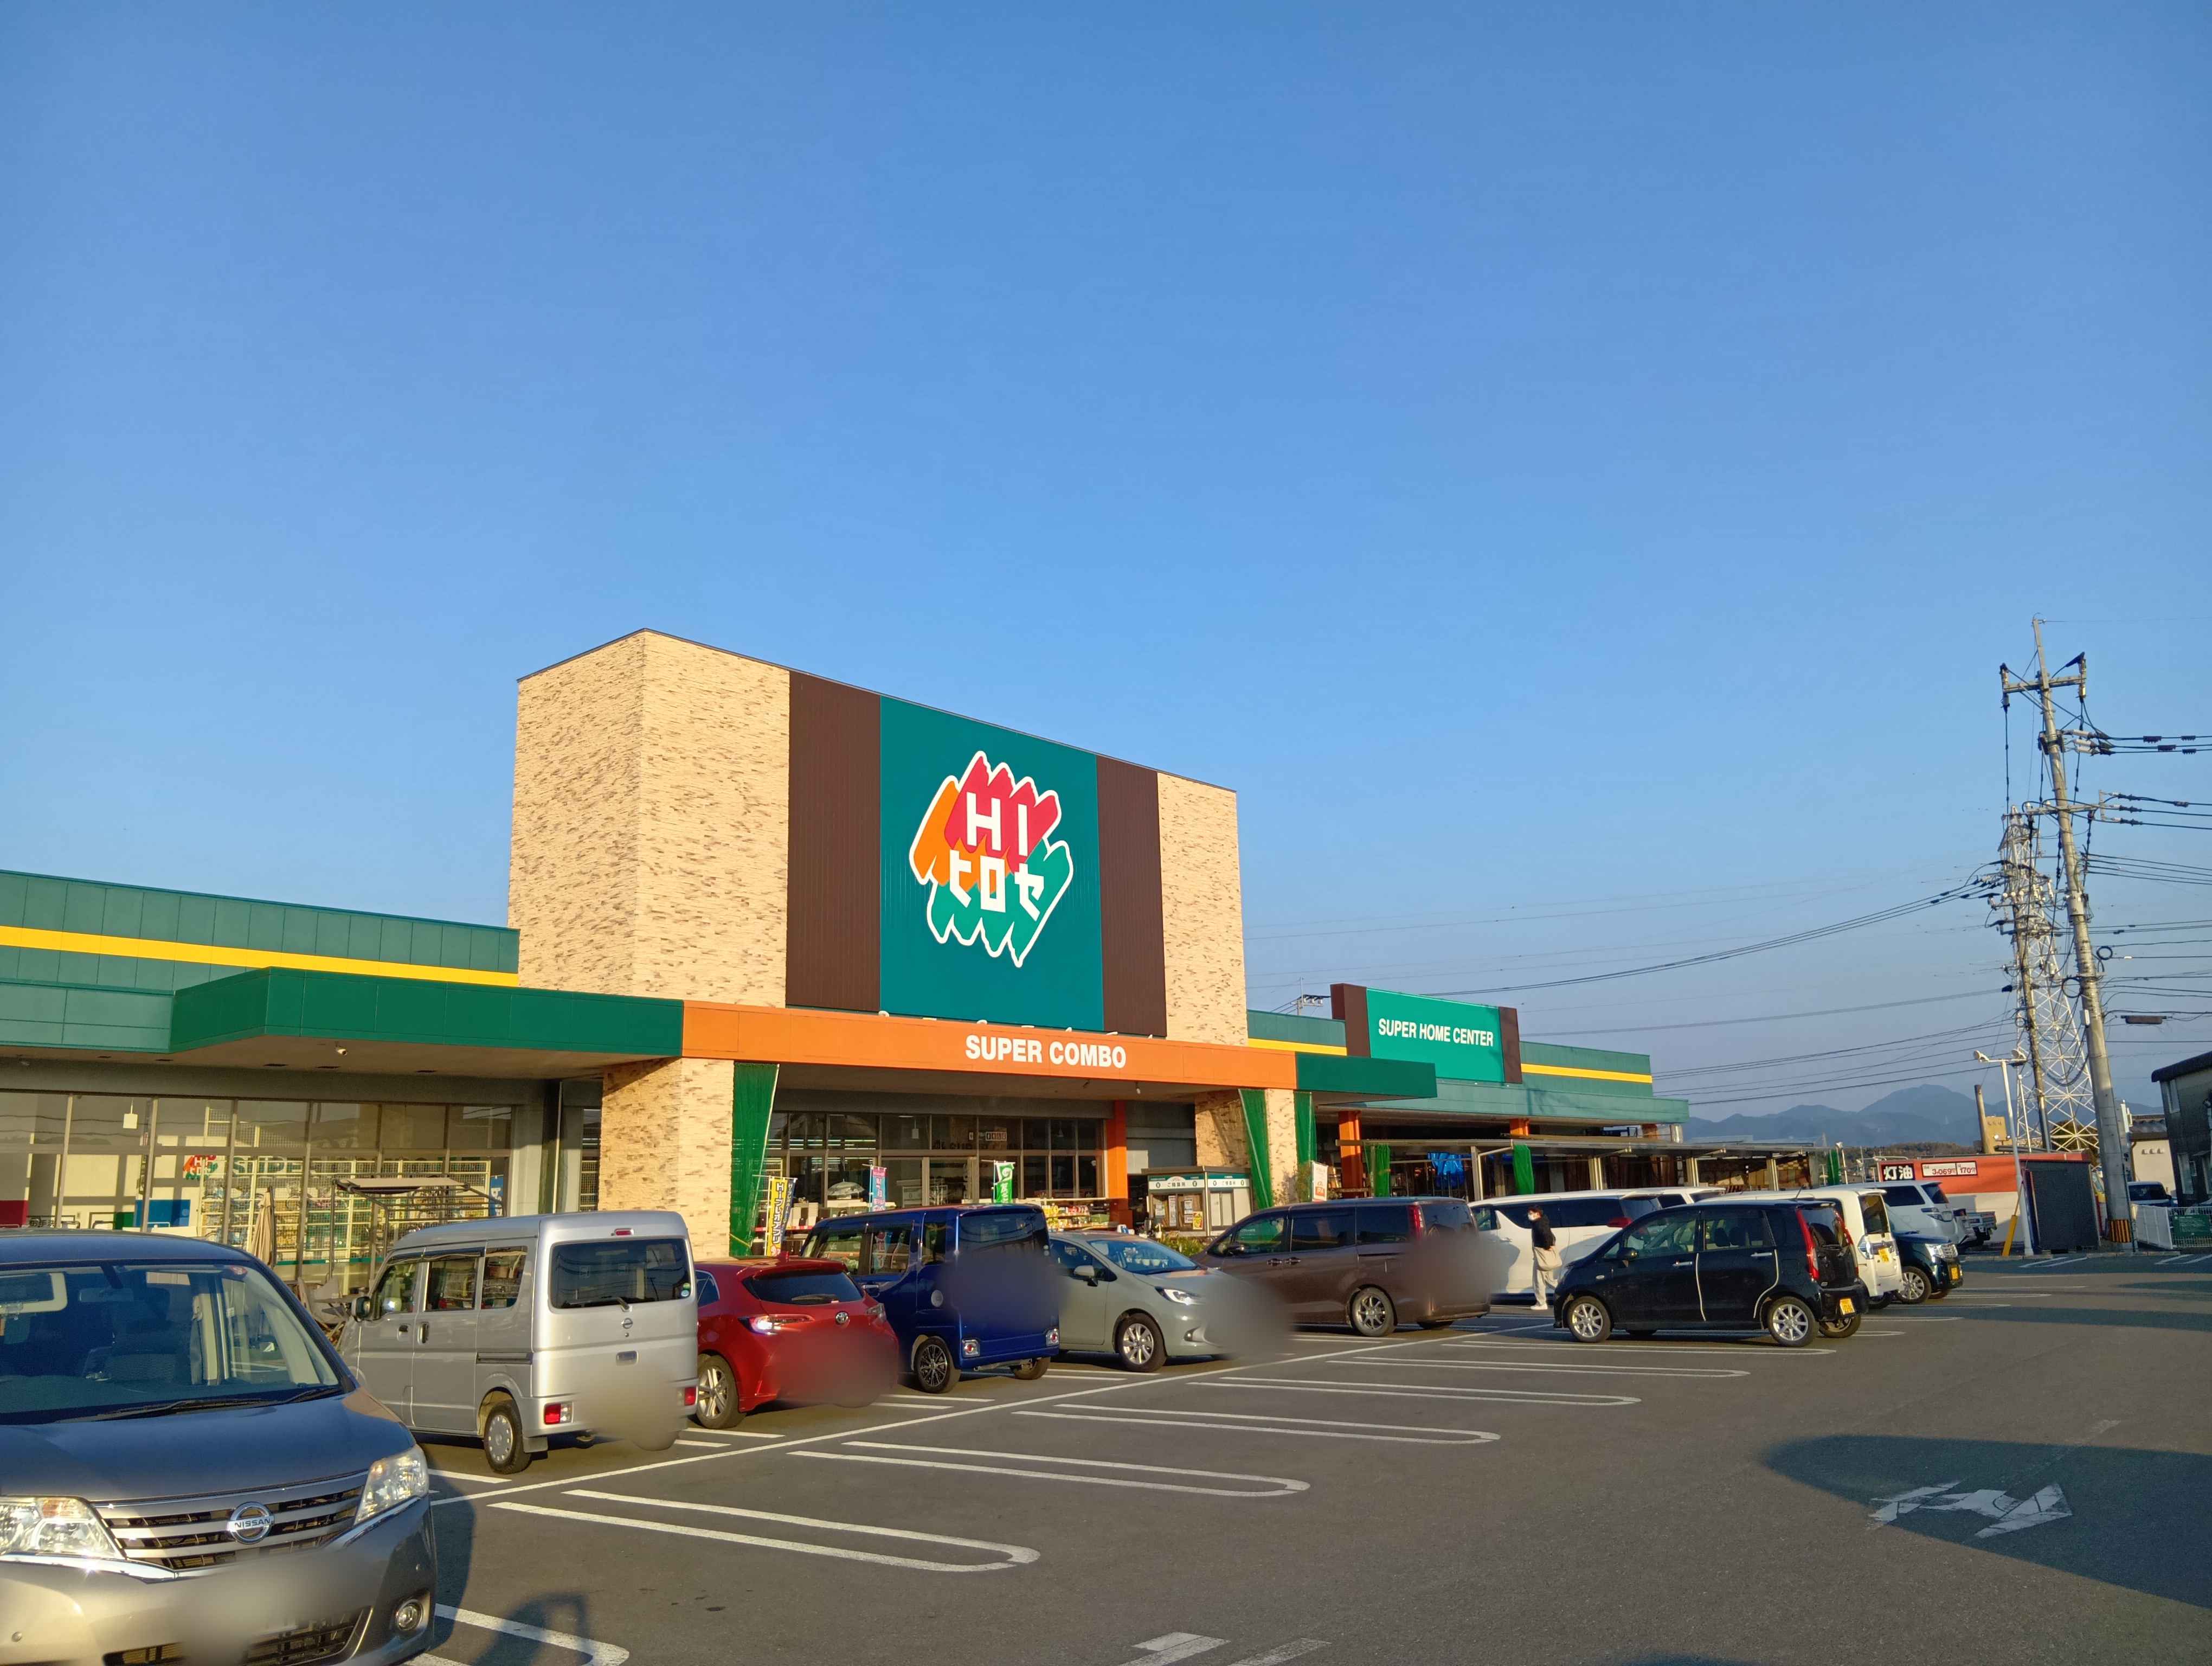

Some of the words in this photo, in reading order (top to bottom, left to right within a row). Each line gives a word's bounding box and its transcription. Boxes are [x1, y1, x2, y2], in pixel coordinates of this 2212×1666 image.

[967, 792, 1028, 857] HI
[949, 849, 1045, 922] ヒロセ
[1378, 1018, 1417, 1039] SUPER
[1419, 1023, 1451, 1042] HOME
[1452, 1027, 1494, 1047] CENTER
[965, 1034, 1043, 1063] SUPER
[1049, 1041, 1127, 1069] COMBO
[1883, 1165, 1914, 1181] 灯油
[234, 1518, 271, 1528] NISSAN
